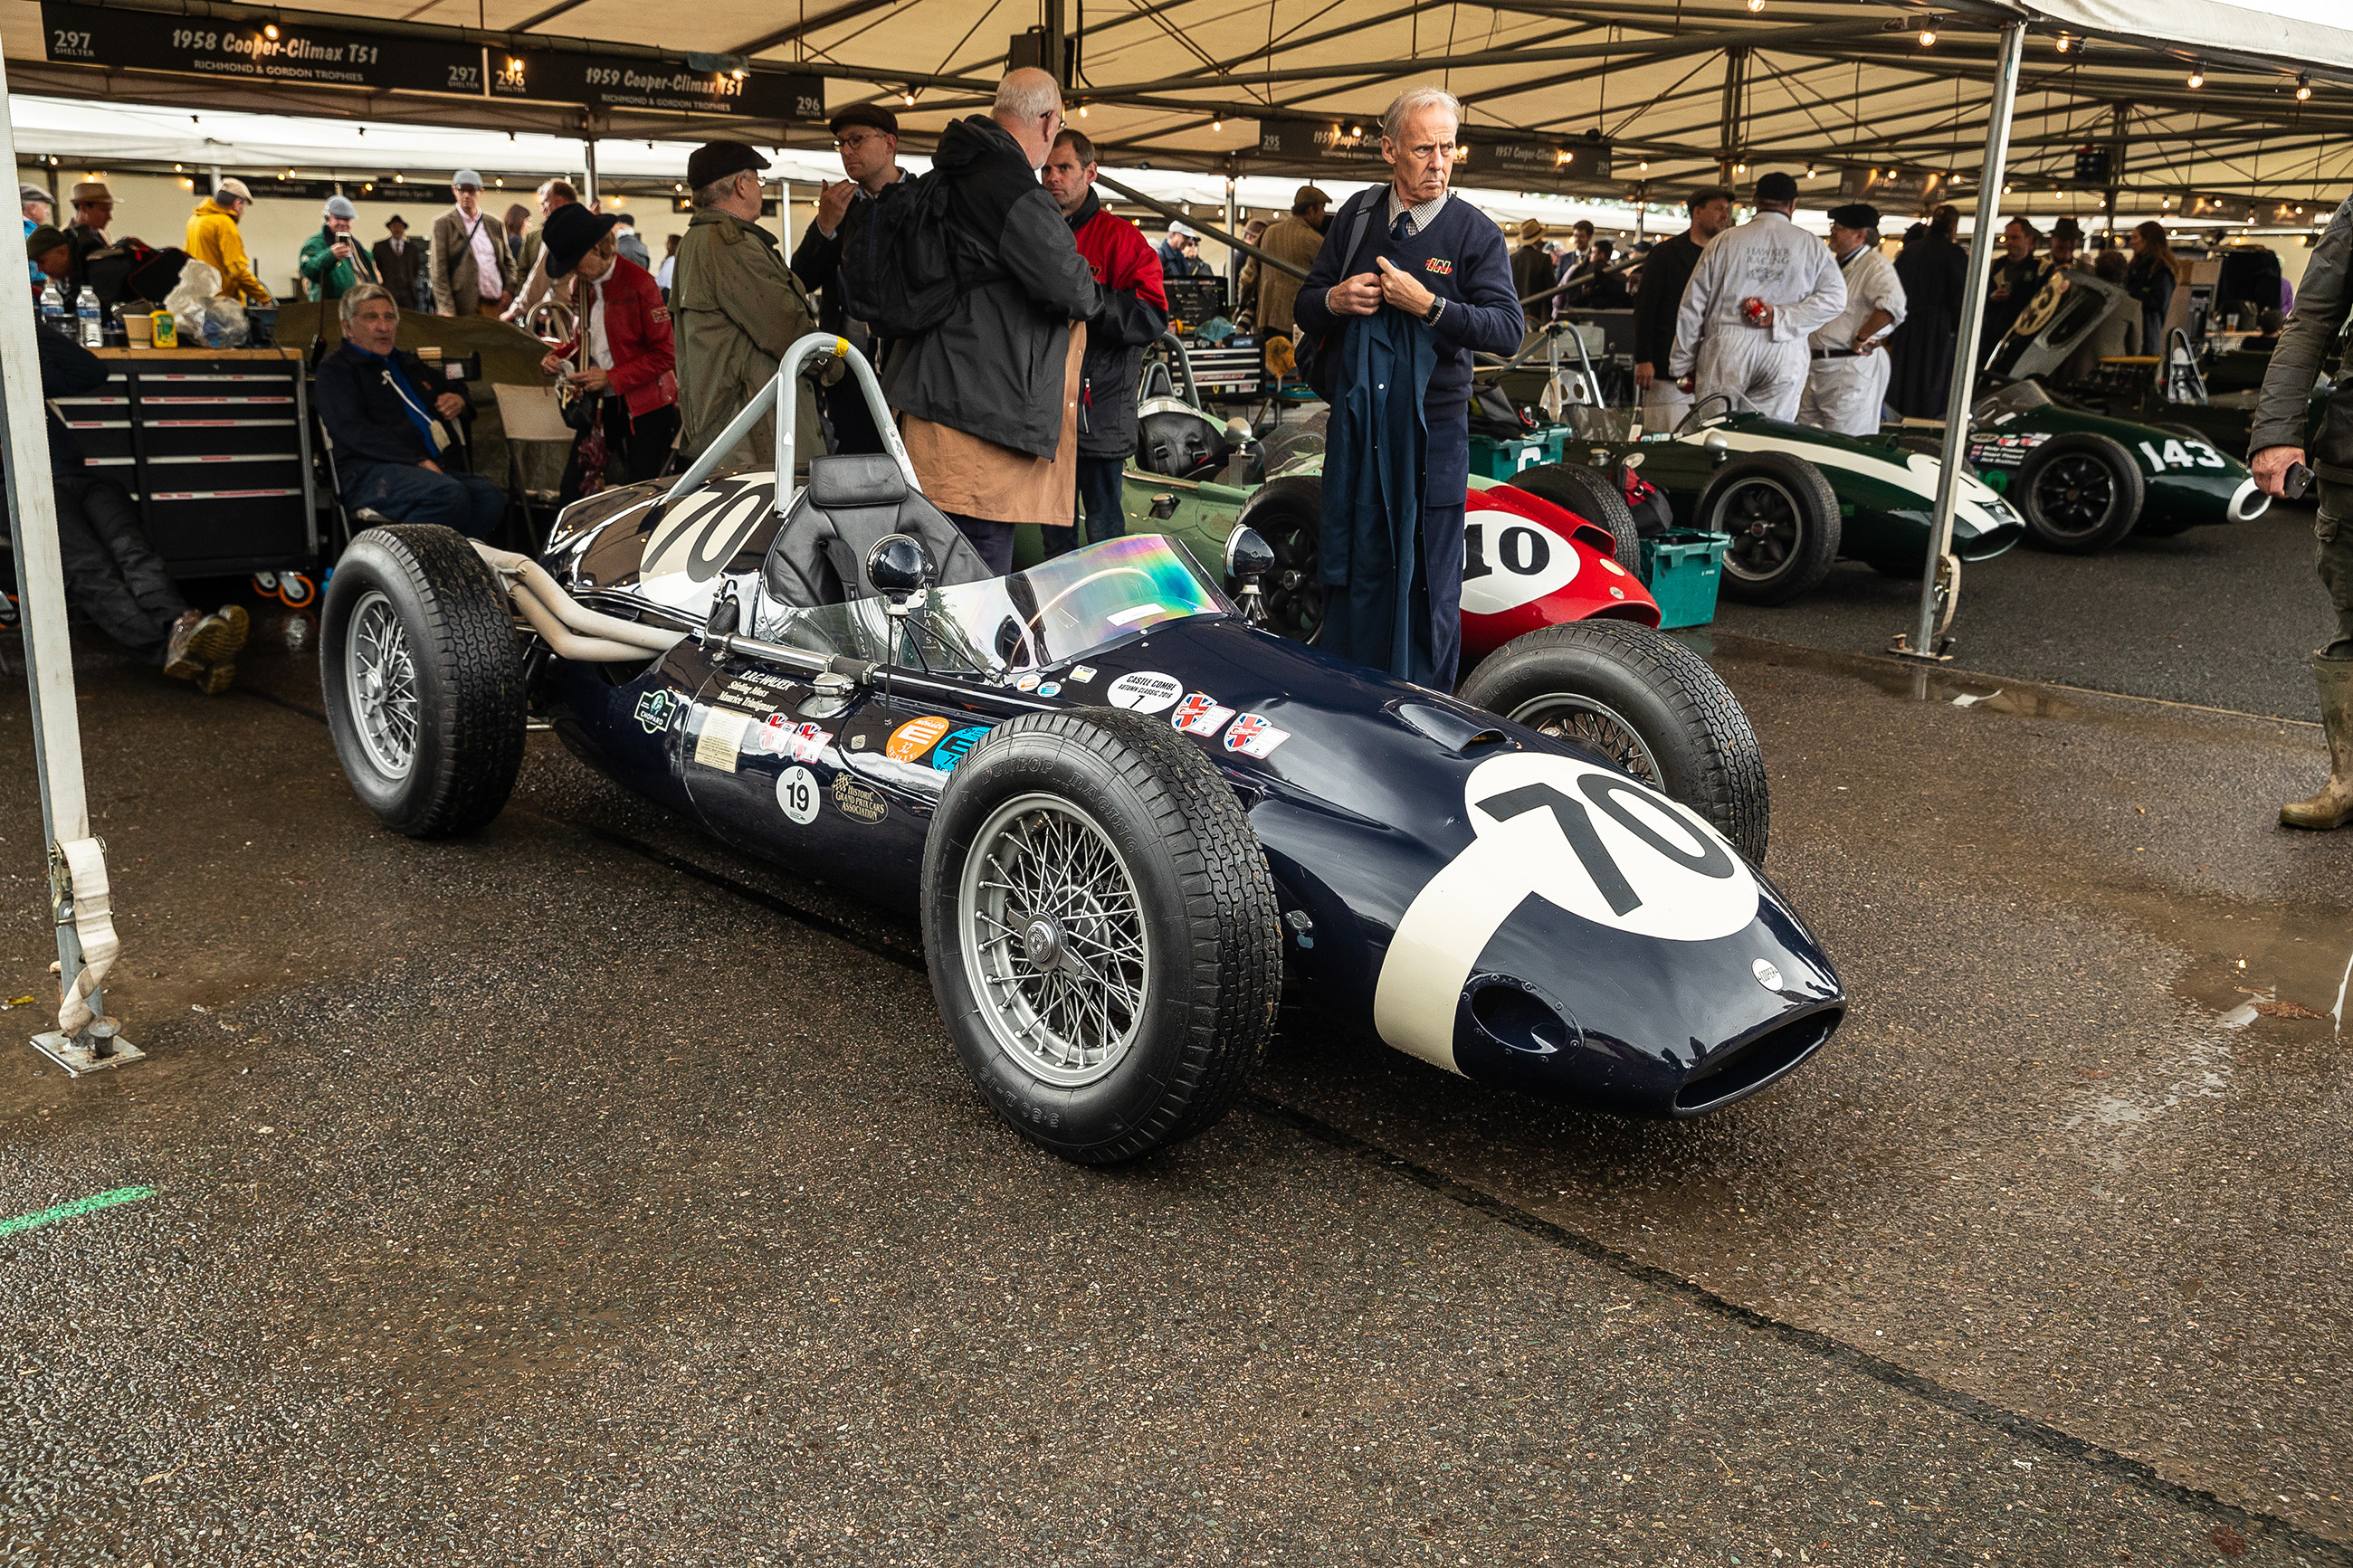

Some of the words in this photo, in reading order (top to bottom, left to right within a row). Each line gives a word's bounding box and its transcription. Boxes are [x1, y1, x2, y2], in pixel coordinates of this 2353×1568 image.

[54, 30, 90, 49] 297
[173, 29, 217, 51] 1958
[223, 33, 343, 62] Cooper-Climax
[348, 43, 378, 64] T51
[54, 47, 94, 57] SHELTER
[194, 60, 253, 74] RICHMOND
[255, 64, 264, 74] &
[266, 66, 313, 78] GORDON
[315, 70, 364, 82] TROPHIES
[448, 65, 477, 82] 297
[496, 71, 525, 87] 296
[586, 66, 621, 86] 1959
[624, 69, 717, 93] Cooper-Climax
[720, 77, 743, 97] T51
[601, 93, 647, 105] RICHMOND
[656, 97, 692, 108] GORDON
[693, 100, 731, 112] TROPHIES
[796, 96, 821, 111] 296
[1263, 135, 1281, 147] 295
[2139, 439, 2225, 472] 143
[639, 480, 776, 584] 70
[1462, 523, 1550, 582] 10
[728, 680, 753, 695] Stirling
[749, 686, 769, 698] Moss
[760, 675, 795, 691] WALKER
[1118, 683, 1138, 692] AUTUMN
[1138, 688, 1160, 696] CLASSIC
[1127, 675, 1153, 687] CASTLE
[1151, 680, 1177, 691] COMBE
[717, 690, 743, 705] Maurice
[741, 696, 779, 713] Trintignant
[1129, 694, 1146, 709] 7
[640, 710, 664, 726] CHOPARD
[915, 719, 946, 730] MONACO
[898, 741, 914, 755] 32
[981, 757, 1055, 787] DUNLOP
[786, 782, 810, 813] 19
[835, 790, 855, 805] GRAND
[855, 796, 870, 808] PRIX
[869, 801, 885, 814] CARS
[848, 784, 874, 802] HISTORIC
[842, 801, 879, 822] ASSOCIATION
[1069, 772, 1140, 853] RACING
[1474, 774, 1735, 917] 70
[1759, 967, 1777, 982] COOPER
